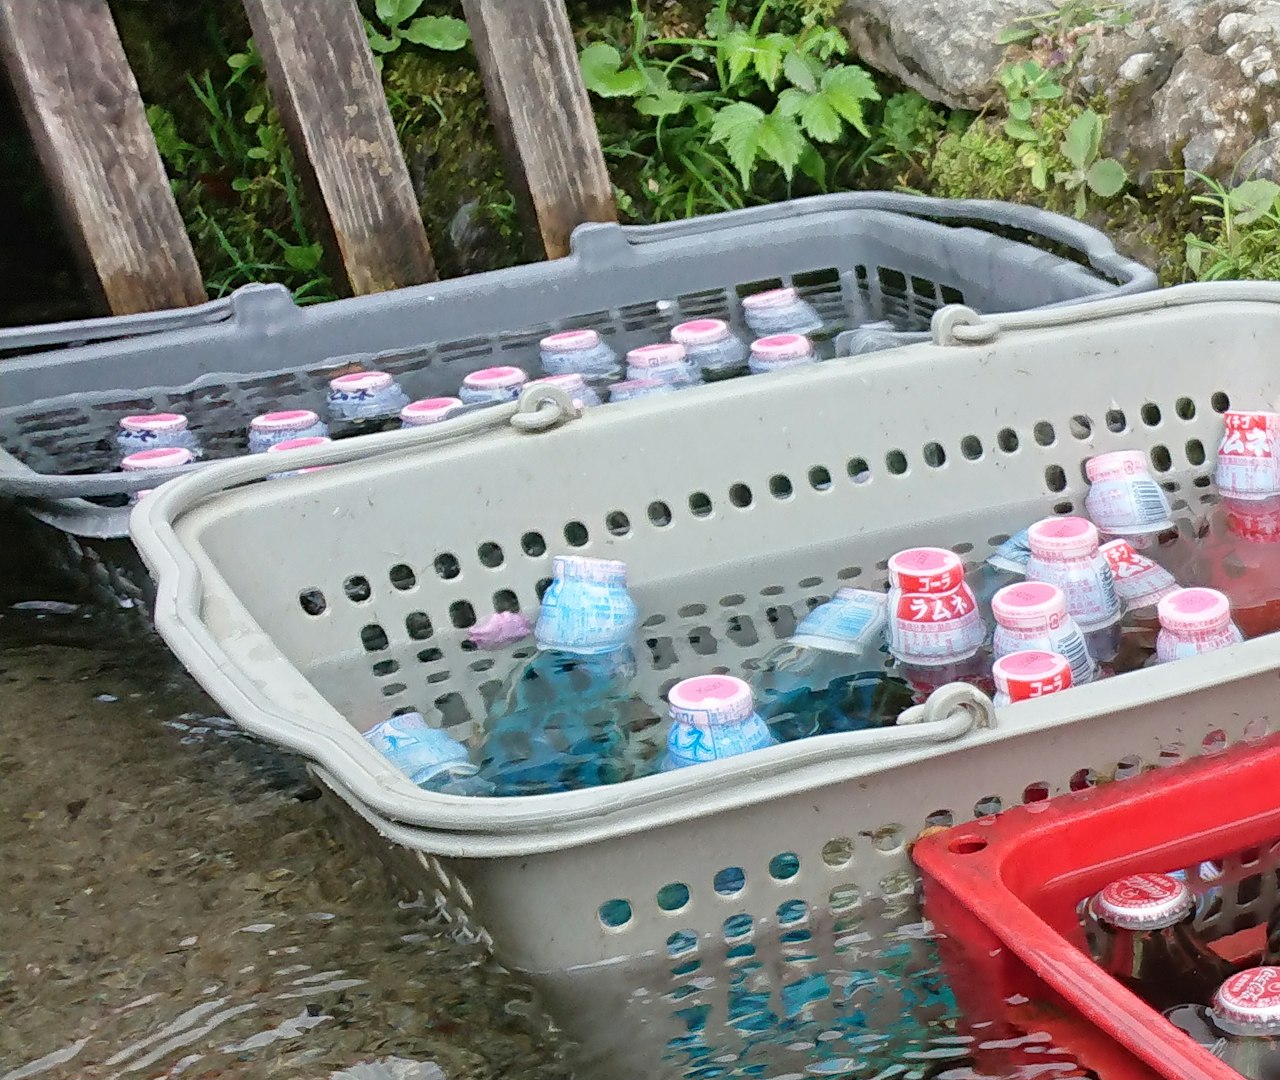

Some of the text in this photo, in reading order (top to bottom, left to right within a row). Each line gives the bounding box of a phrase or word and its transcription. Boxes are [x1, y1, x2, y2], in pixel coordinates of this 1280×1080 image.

[918, 573, 951, 593] コーラ
[910, 594, 968, 621] ラムネ
[1029, 675, 1064, 698] コーラ
[1240, 968, 1278, 1002] Coca-Cola
